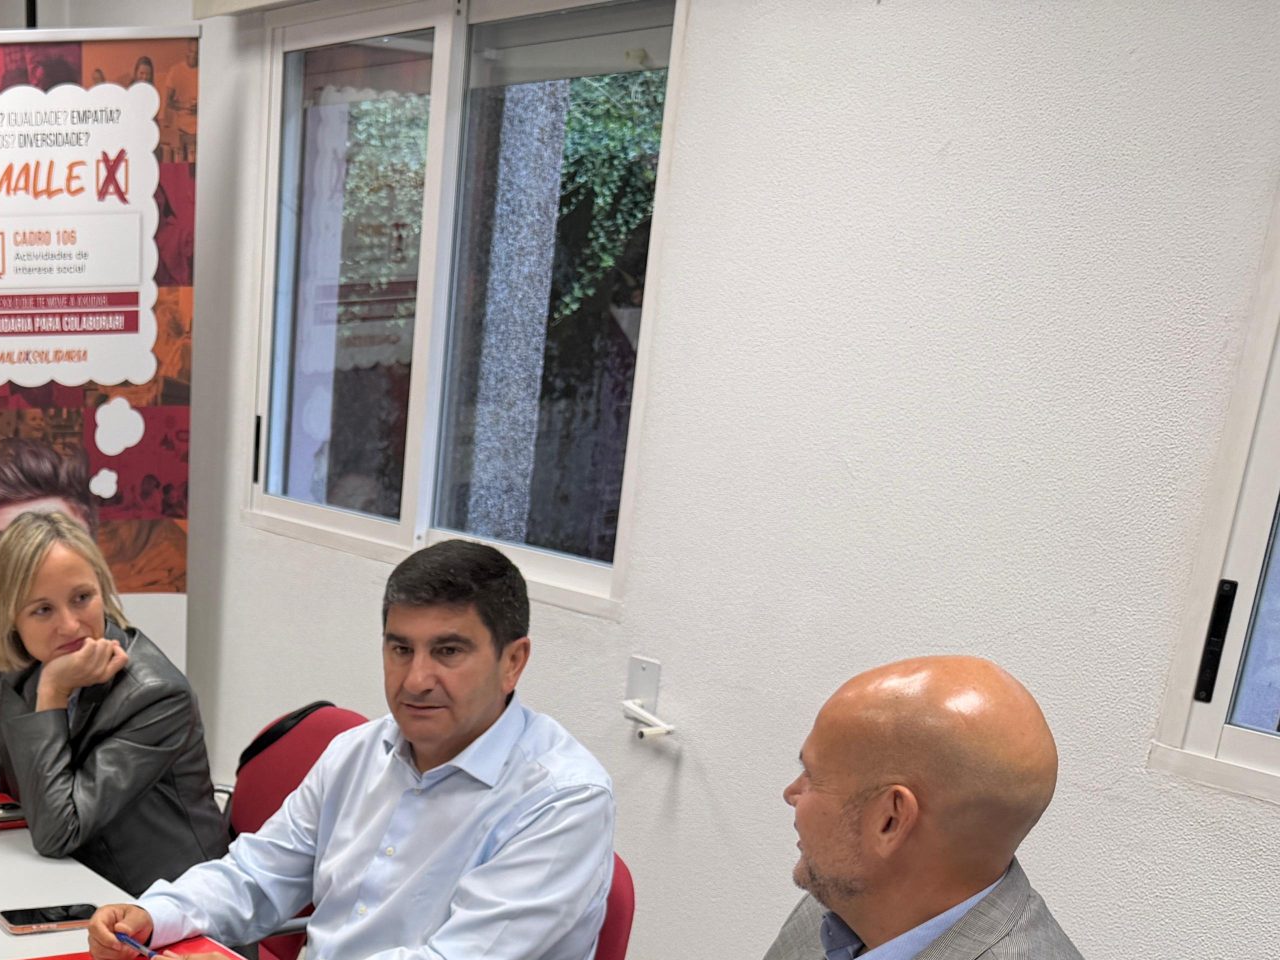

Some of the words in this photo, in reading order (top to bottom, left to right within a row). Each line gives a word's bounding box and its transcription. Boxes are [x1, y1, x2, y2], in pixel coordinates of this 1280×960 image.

[71, 107, 122, 126] EMPATÍA?
[19, 131, 91, 148] DIVERSIDADE?
[13, 231, 52, 247] CADRO
[56, 230, 78, 246] 106
[14, 250, 74, 262] Actividades
[75, 250, 89, 261] de
[56, 262, 87, 274] social
[34, 315, 61, 332] PARA
